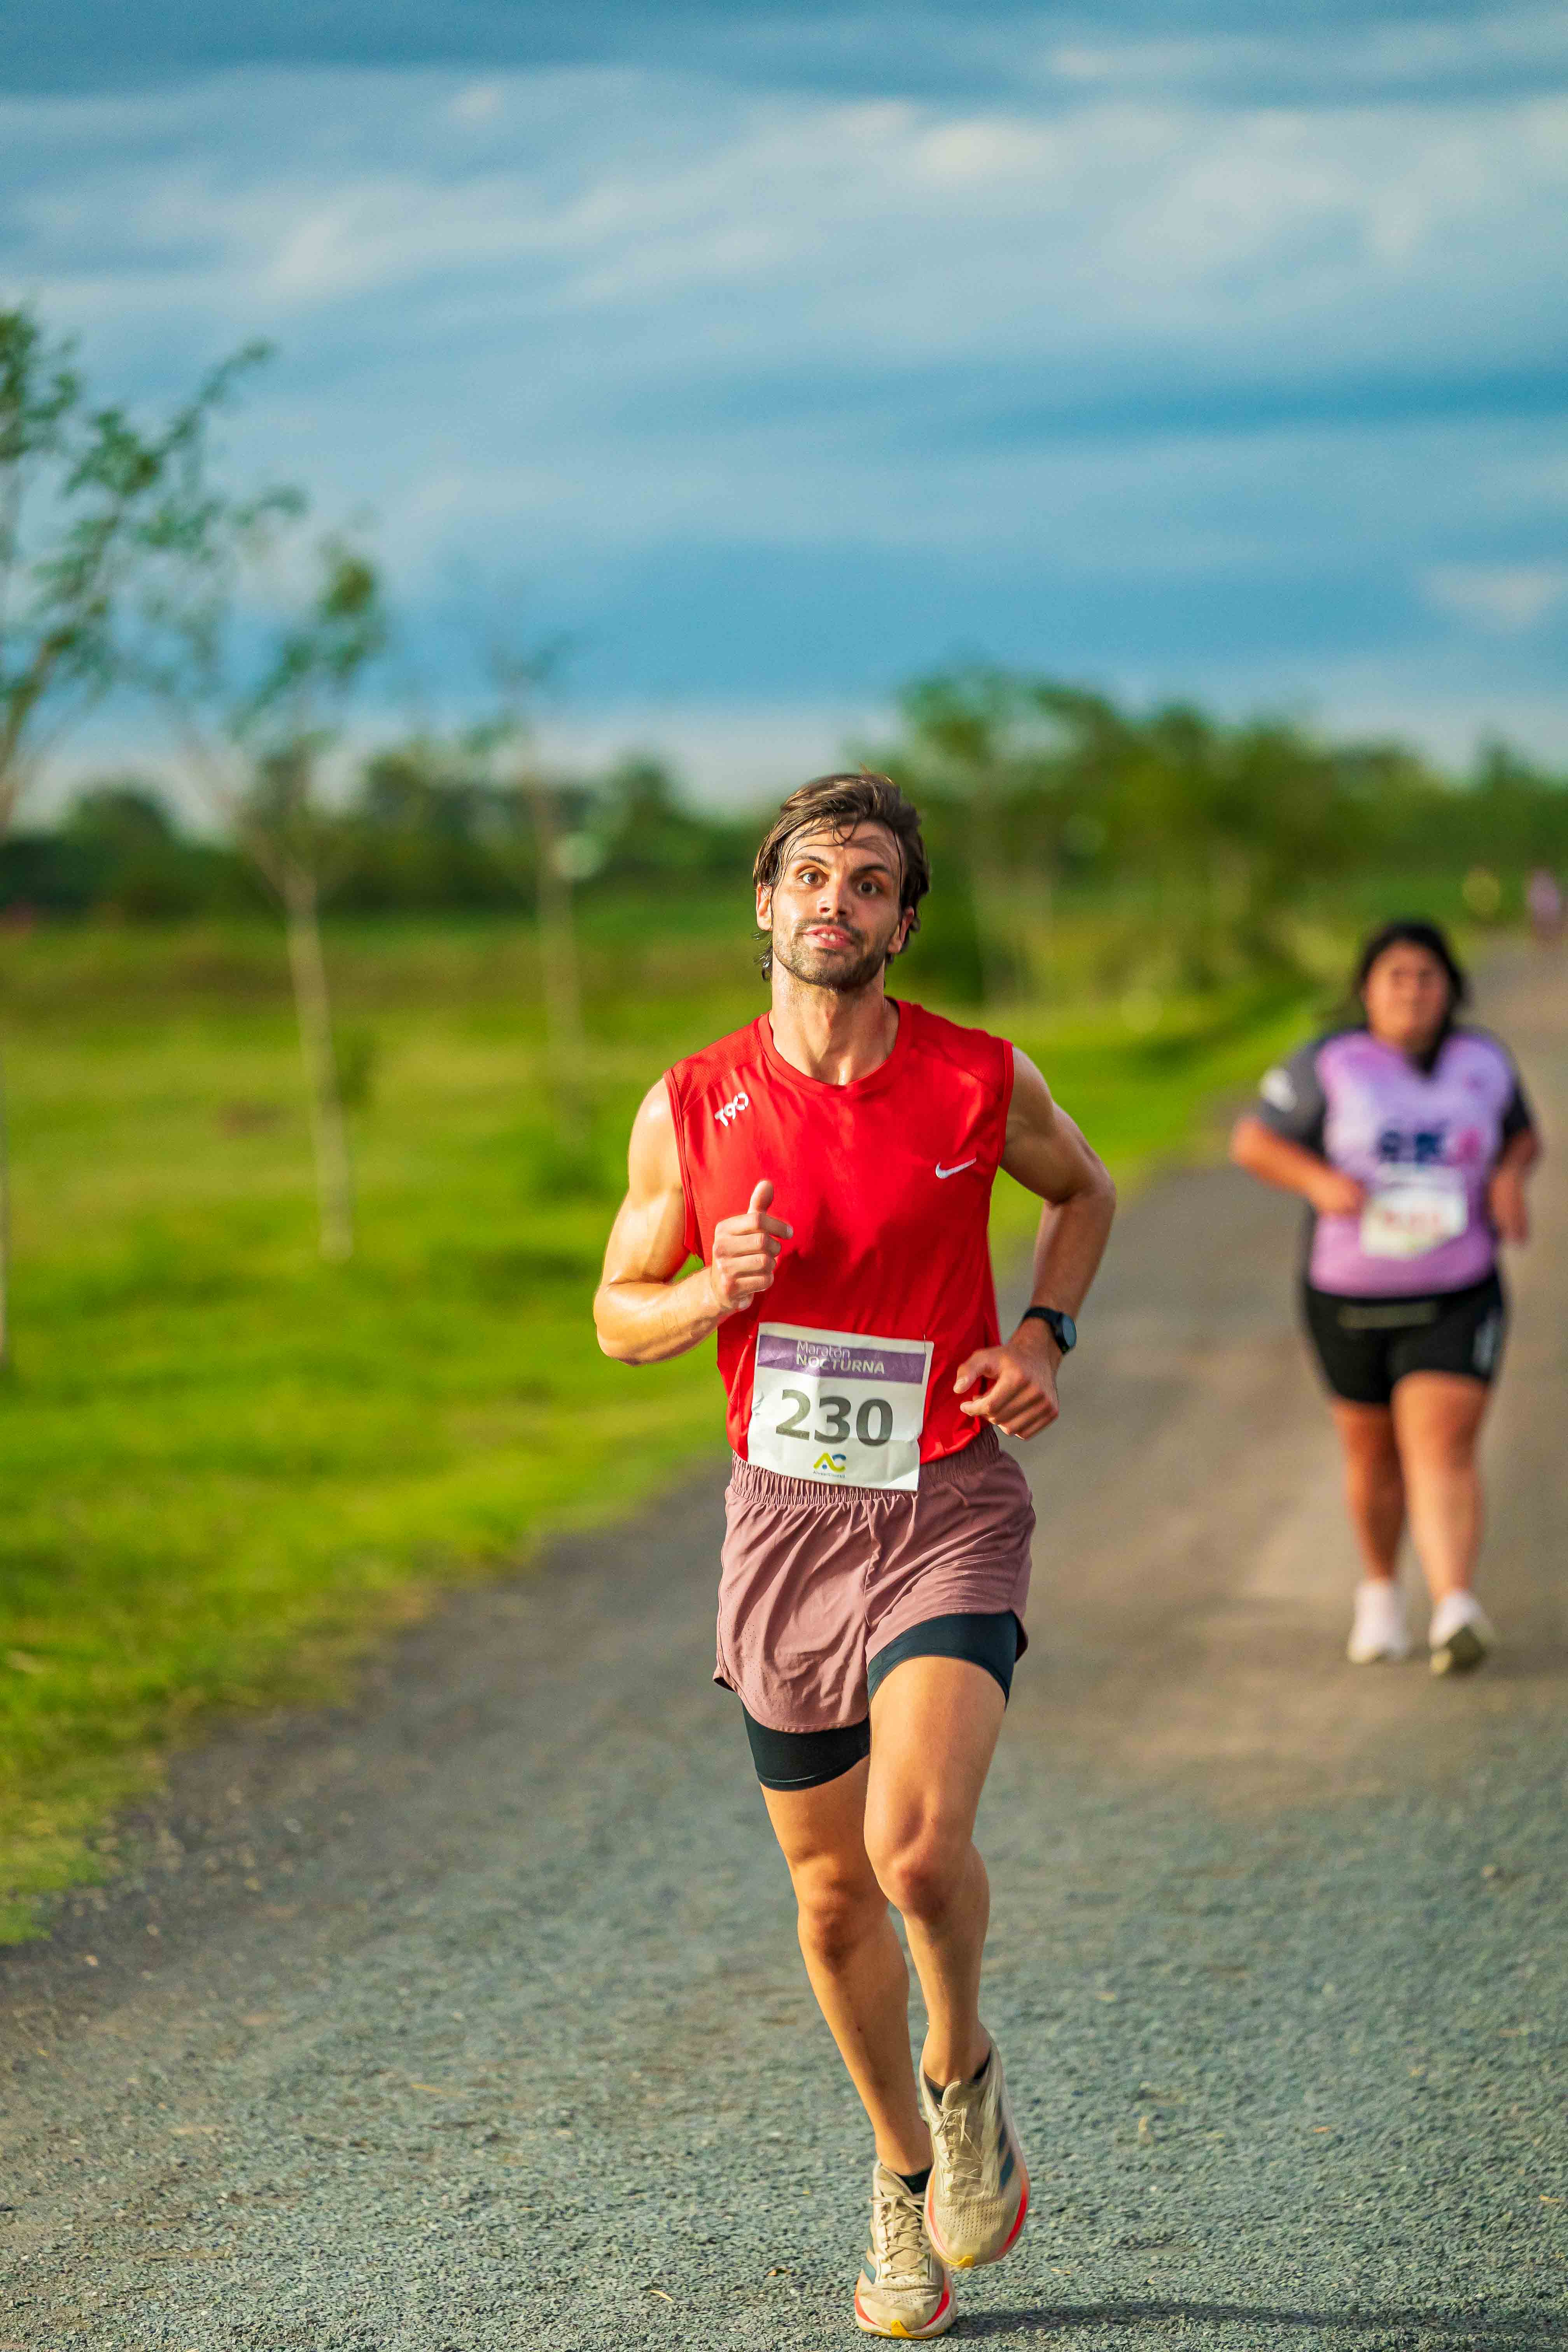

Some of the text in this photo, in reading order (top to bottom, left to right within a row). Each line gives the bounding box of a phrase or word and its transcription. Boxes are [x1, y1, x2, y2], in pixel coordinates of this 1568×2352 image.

[714, 1092, 749, 1127] T90
[797, 1340, 850, 1359] Maratón
[796, 1353, 885, 1375] NOCTURNA
[776, 1389, 893, 1447] 230
